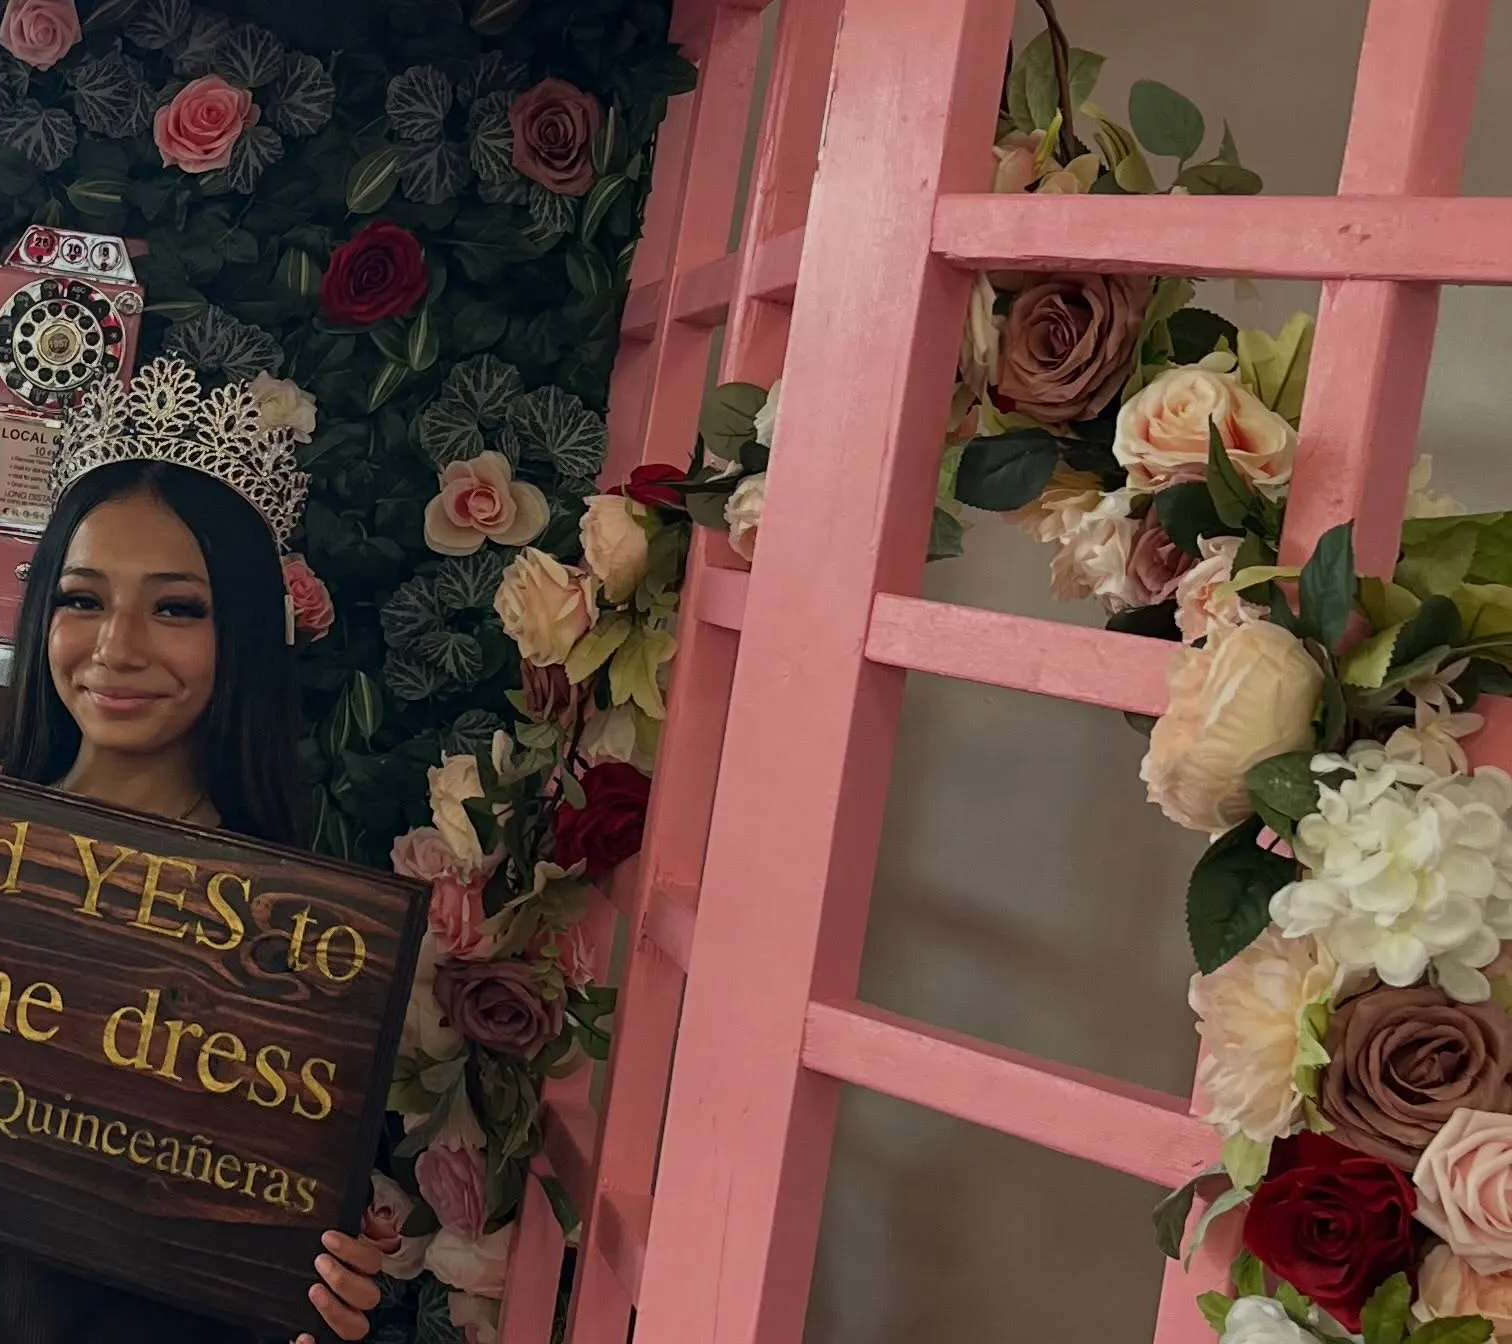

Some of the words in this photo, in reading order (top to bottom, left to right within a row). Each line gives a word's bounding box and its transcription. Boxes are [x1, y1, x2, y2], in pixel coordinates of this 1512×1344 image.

[1, 428, 48, 445] LOCAL
[35, 446, 46, 456] 10
[69, 833, 251, 951] YES
[288, 904, 367, 982] to
[102, 988, 337, 1121] dress
